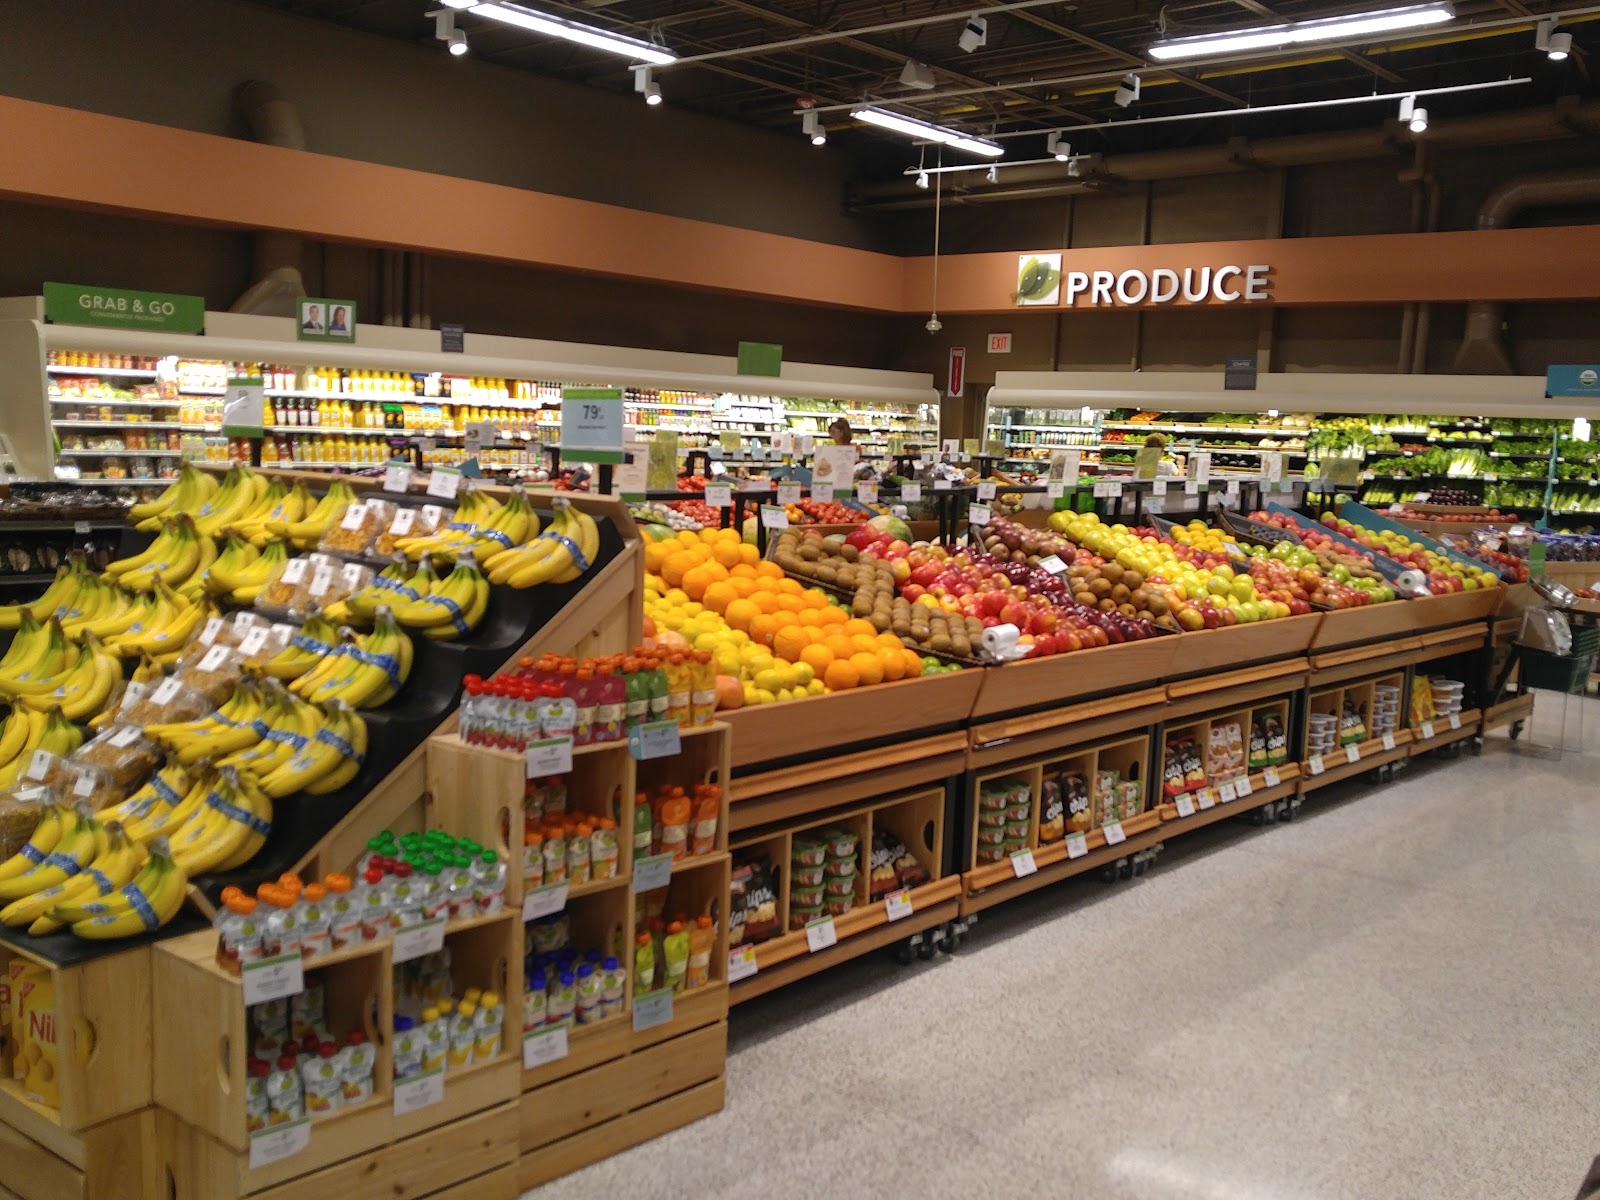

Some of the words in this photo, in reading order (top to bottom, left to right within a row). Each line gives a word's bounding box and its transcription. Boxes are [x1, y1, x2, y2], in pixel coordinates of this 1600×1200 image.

[1066, 265, 1270, 304] PRODUCE
[79, 294, 127, 311] GRAB
[132, 299, 144, 313] &
[148, 300, 175, 315] GO
[992, 336, 1008, 350] EXIT
